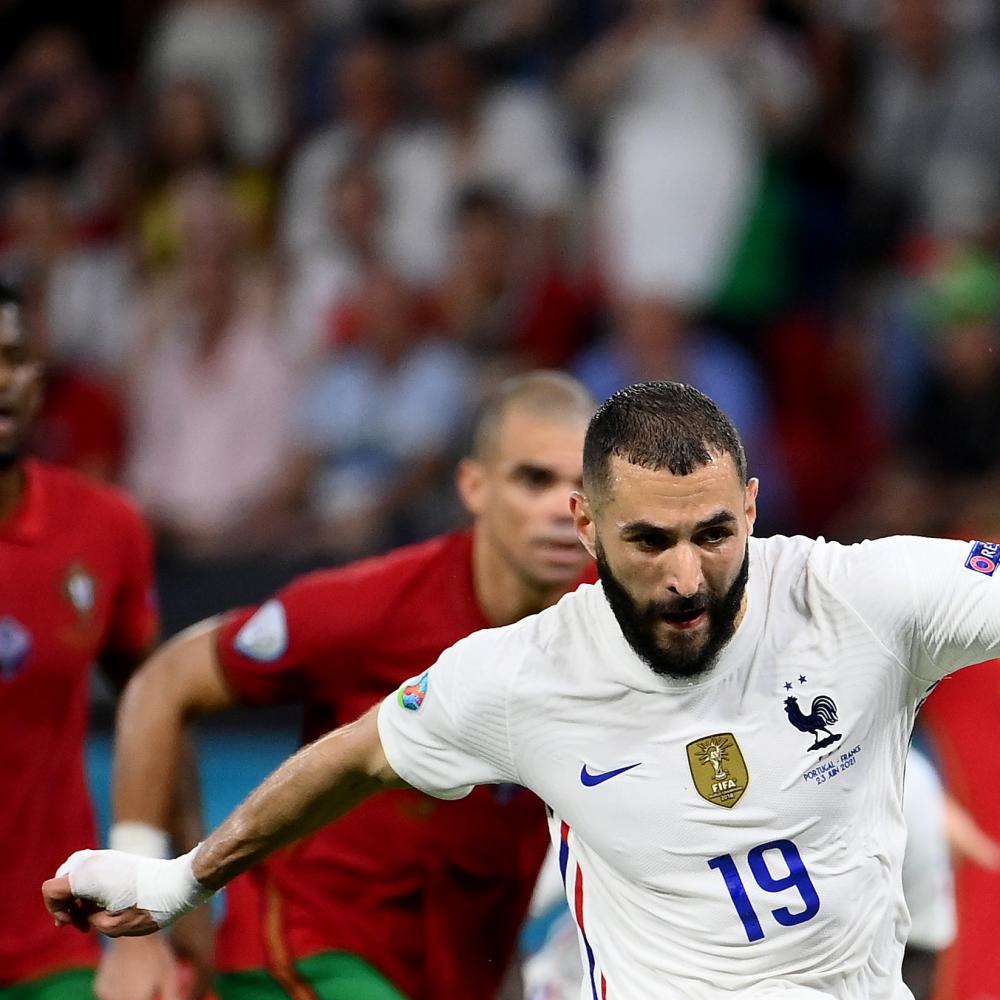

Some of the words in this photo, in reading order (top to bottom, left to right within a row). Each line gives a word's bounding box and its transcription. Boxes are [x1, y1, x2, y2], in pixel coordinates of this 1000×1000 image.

[803, 761, 835, 782] PORTUGAL
[815, 774, 827, 786] 23
[840, 756, 856, 772] 2021
[711, 779, 737, 793] FIFA
[707, 838, 821, 943] 19
